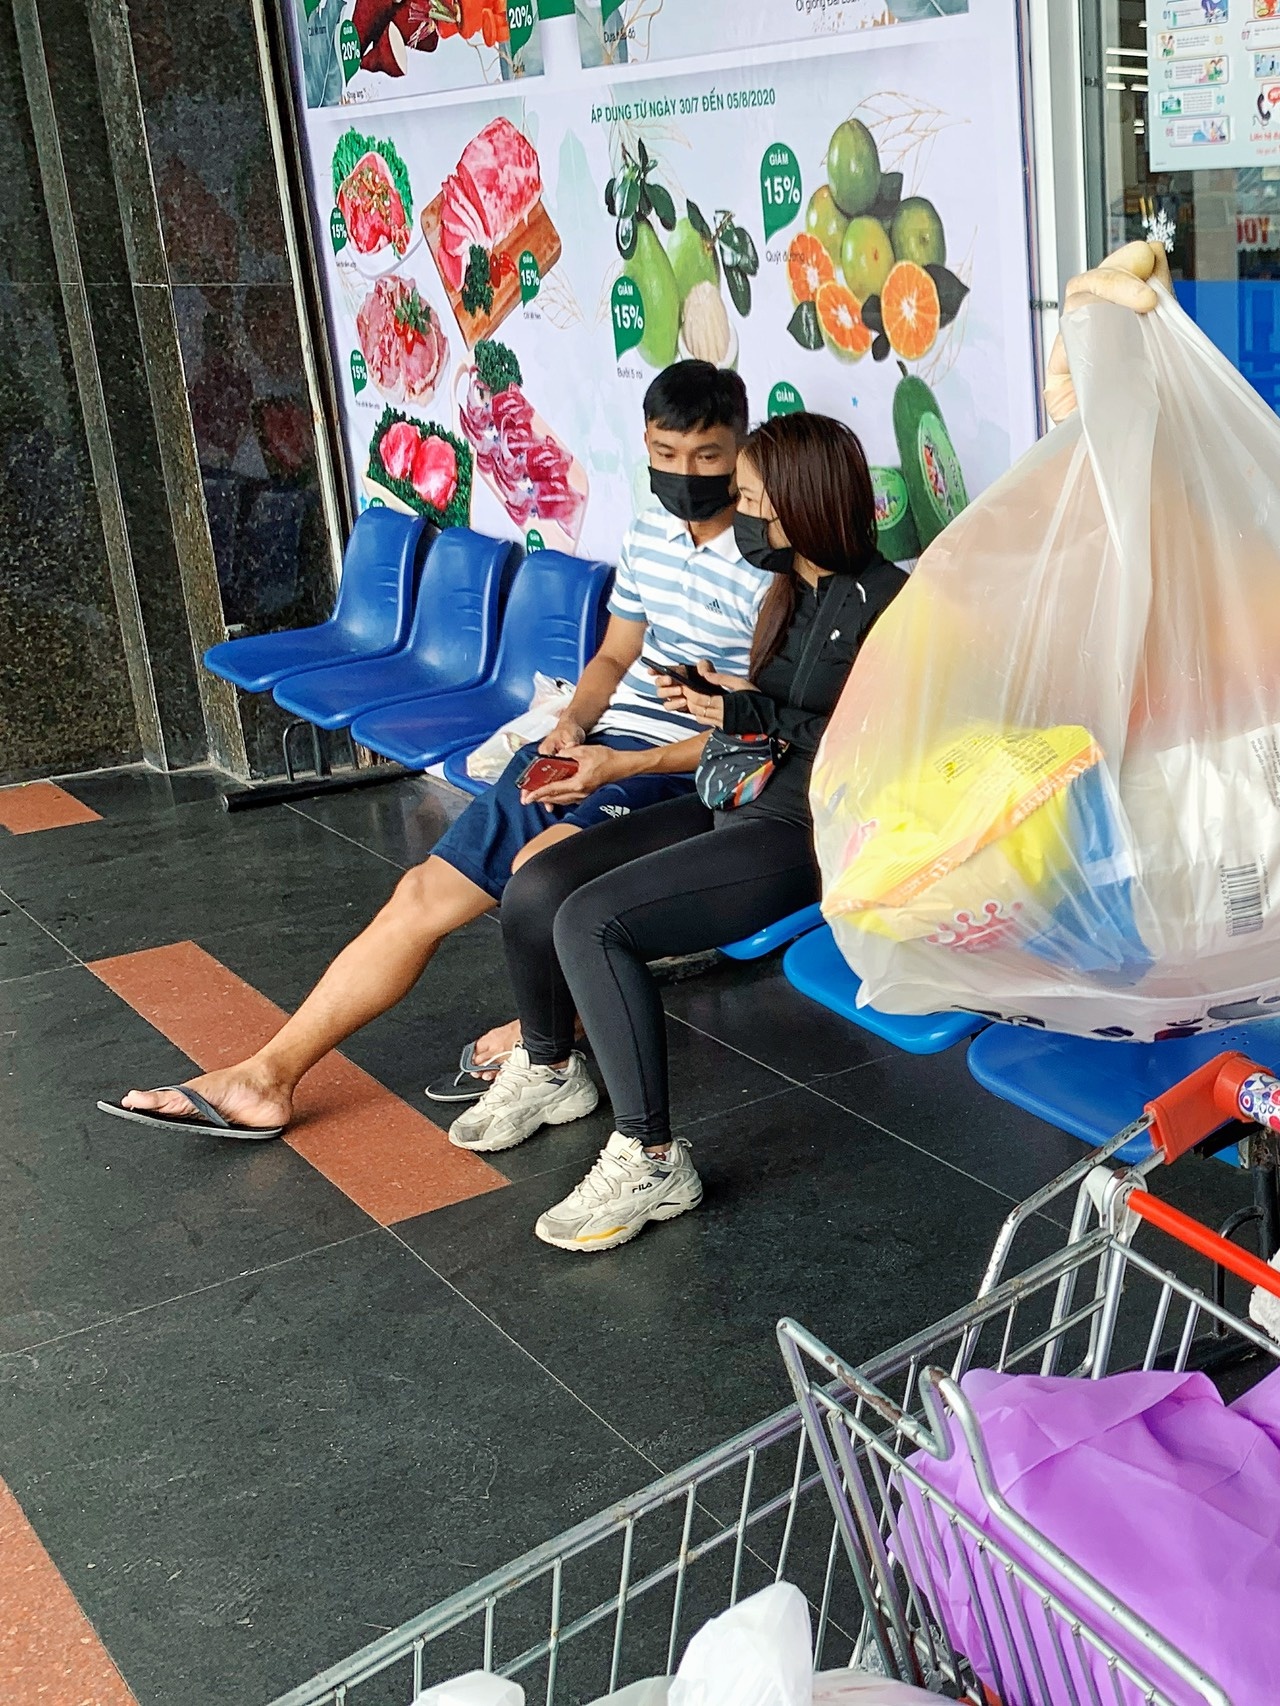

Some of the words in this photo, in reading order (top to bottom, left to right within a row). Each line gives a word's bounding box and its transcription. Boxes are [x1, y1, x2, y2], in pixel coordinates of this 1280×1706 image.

[509, 5, 532, 29] 20%
[342, 42, 361, 61] 20%
[591, 104, 602, 123] ÁP
[606, 104, 631, 123] DỤNG
[633, 99, 647, 118] TỪ
[649, 95, 676, 117] NGÀY
[680, 97, 699, 114] 30/7
[702, 87, 724, 111] ĐẾN
[727, 88, 776, 109] 05/8/2020
[769, 150, 788, 166] GIẢM
[764, 176, 800, 205] 15%
[331, 225, 347, 238] 15%
[521, 269, 539, 285] 15%
[618, 282, 633, 296] GIẢM
[614, 304, 643, 329] 15%
[351, 365, 367, 380] 15%
[776, 387, 794, 403] GIẢM
